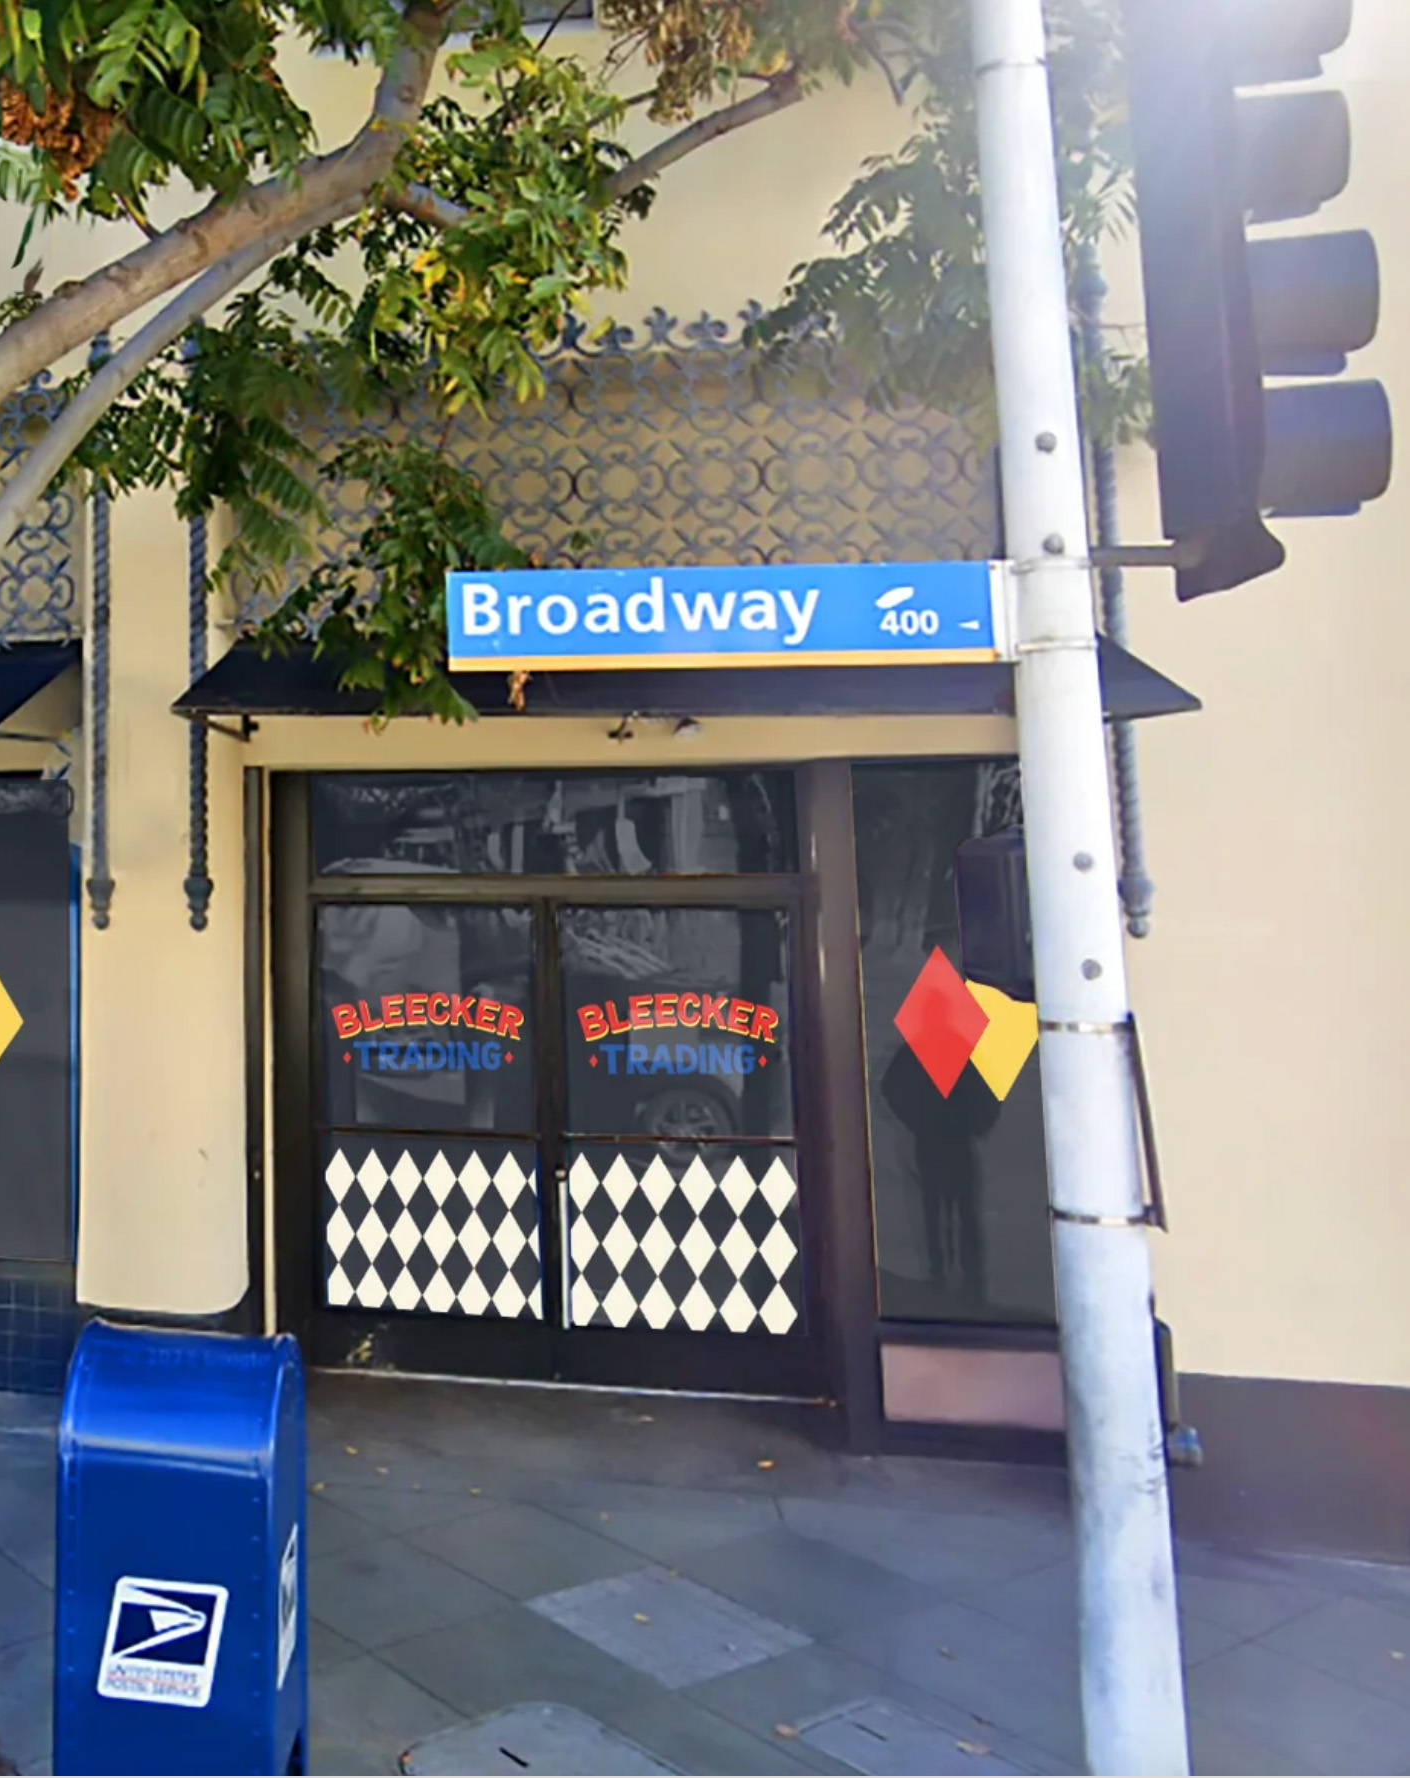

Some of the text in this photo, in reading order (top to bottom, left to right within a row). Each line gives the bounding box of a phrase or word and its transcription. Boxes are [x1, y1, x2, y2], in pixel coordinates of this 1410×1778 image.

[461, 576, 940, 645] Broadway 400
[331, 991, 525, 1041] BLEECKER
[576, 991, 780, 1044] BLEECKER
[352, 1040, 502, 1072] TRADING
[598, 1042, 757, 1076] TRADING
